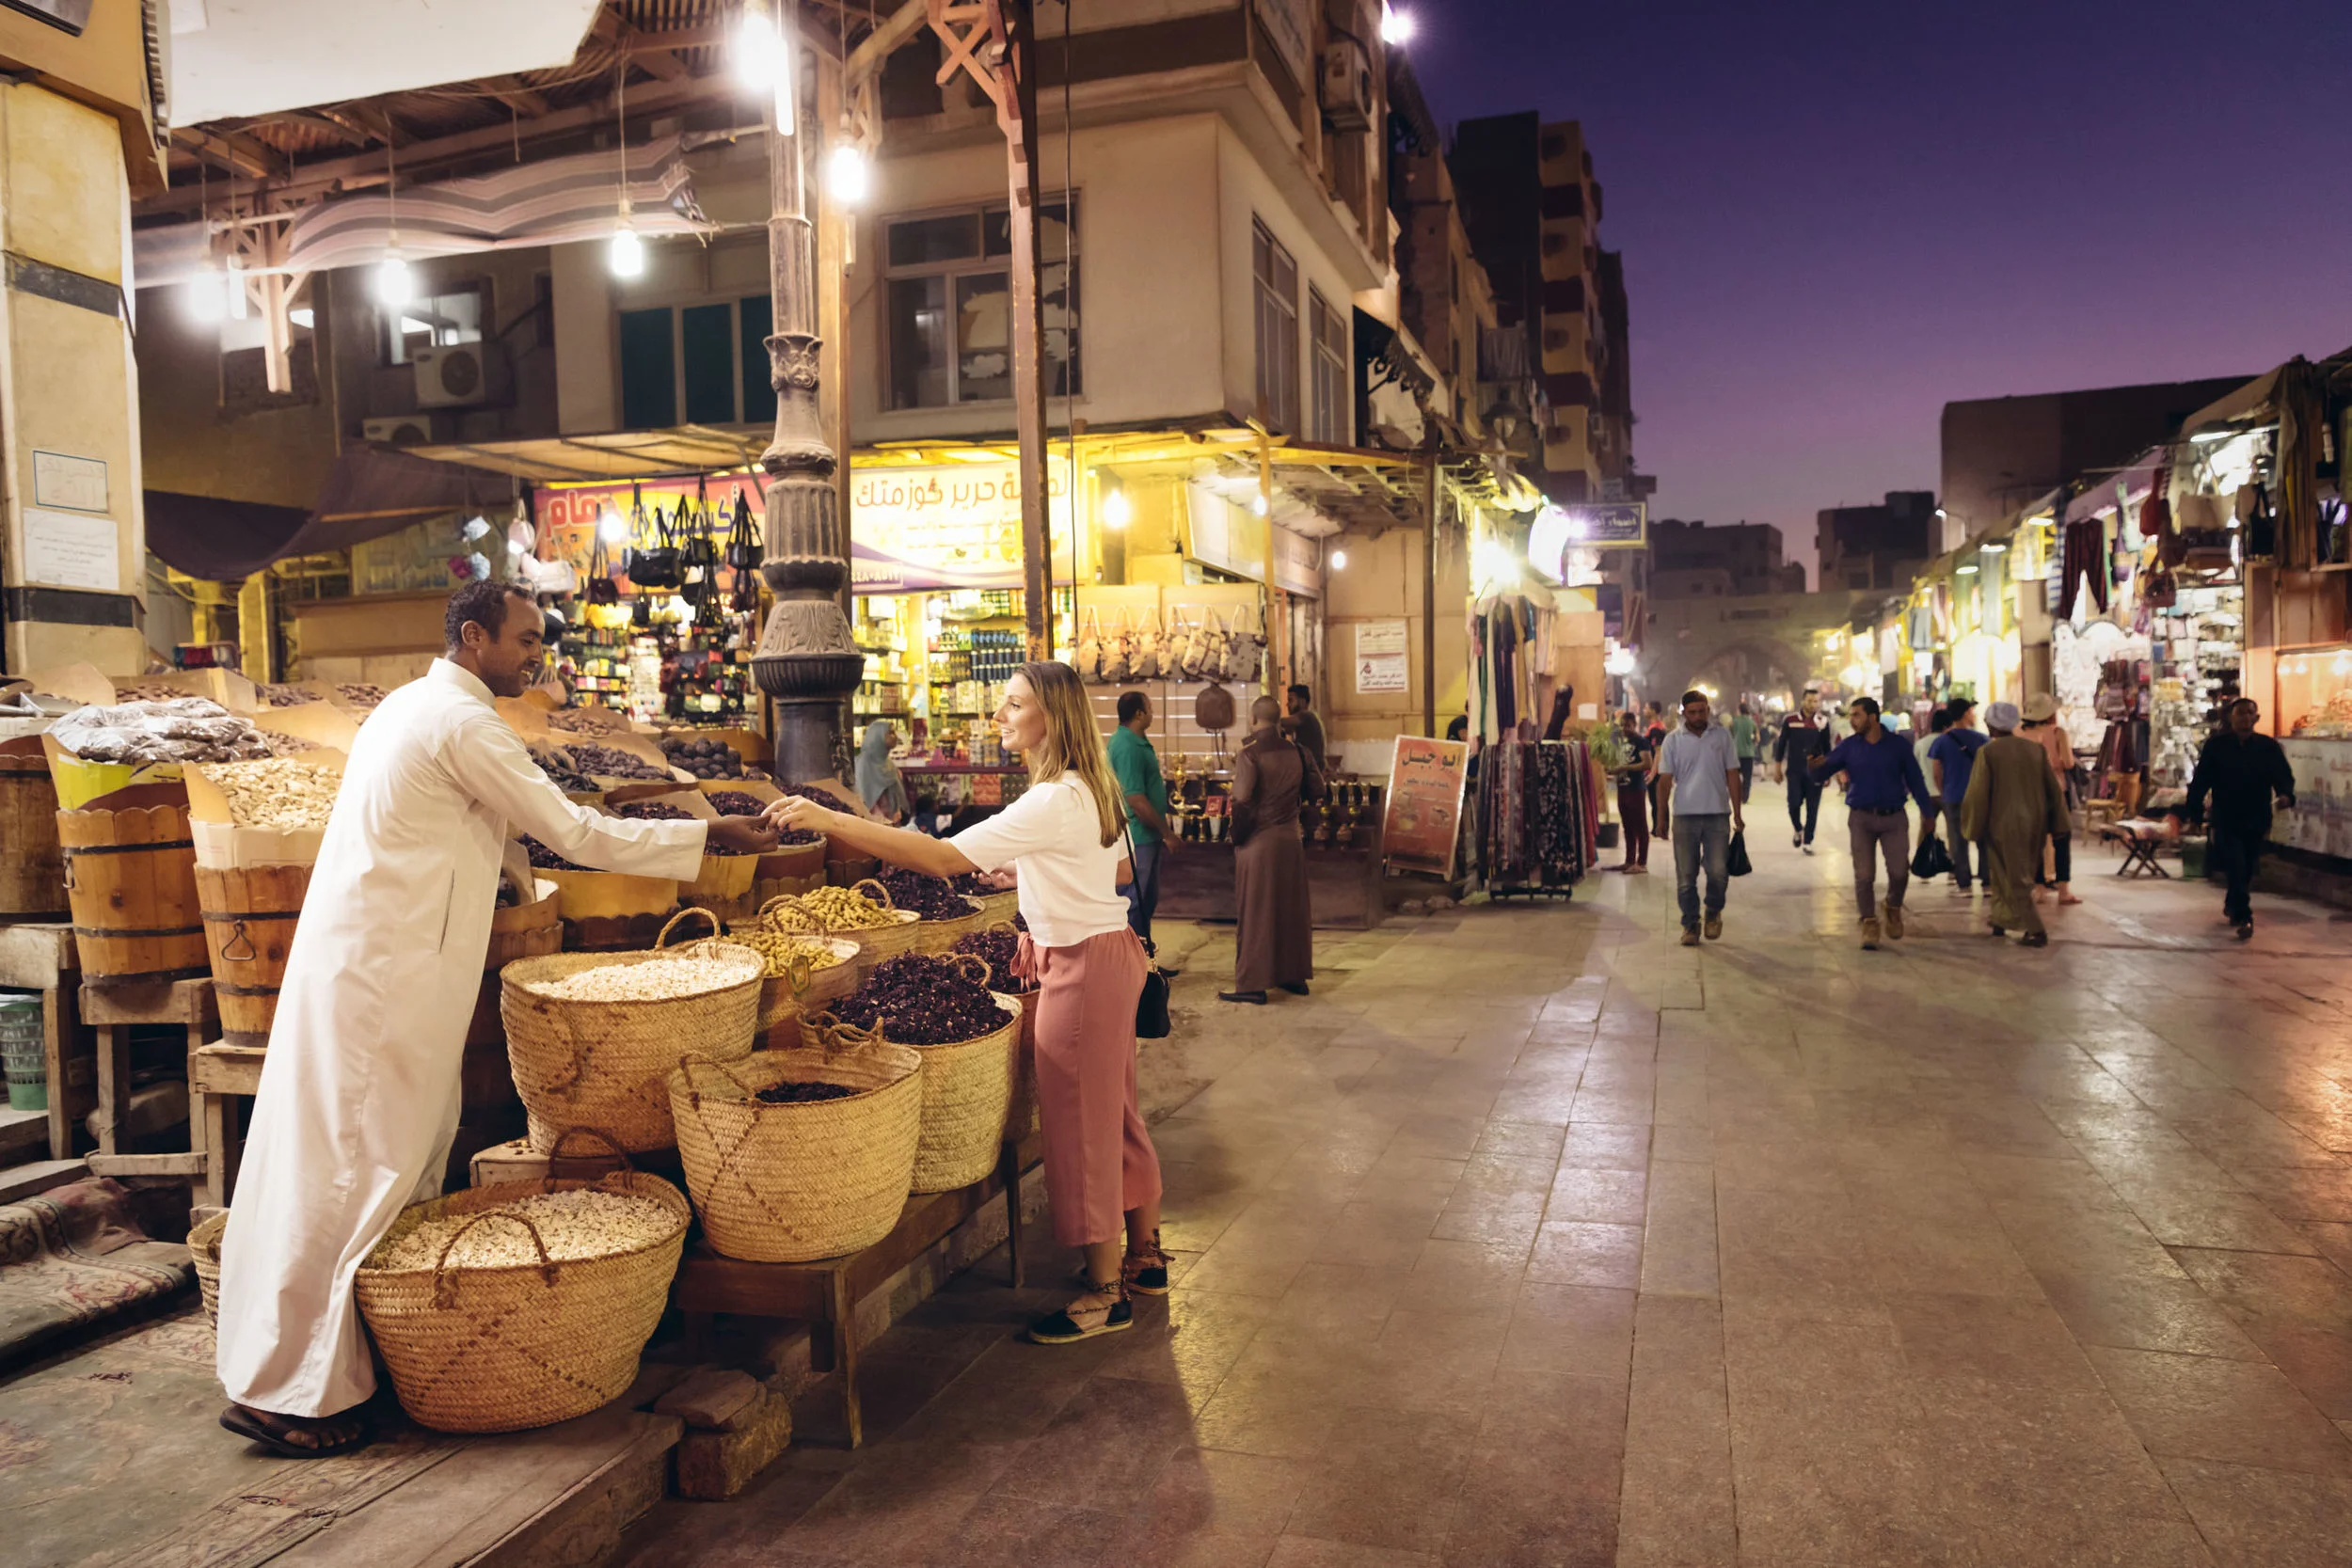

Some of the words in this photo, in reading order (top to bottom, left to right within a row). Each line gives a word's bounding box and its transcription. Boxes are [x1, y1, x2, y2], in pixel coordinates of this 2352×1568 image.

[951, 479, 996, 511] حرير
[1002, 467, 1068, 499] لمة
[1402, 744, 1435, 769] جبل
